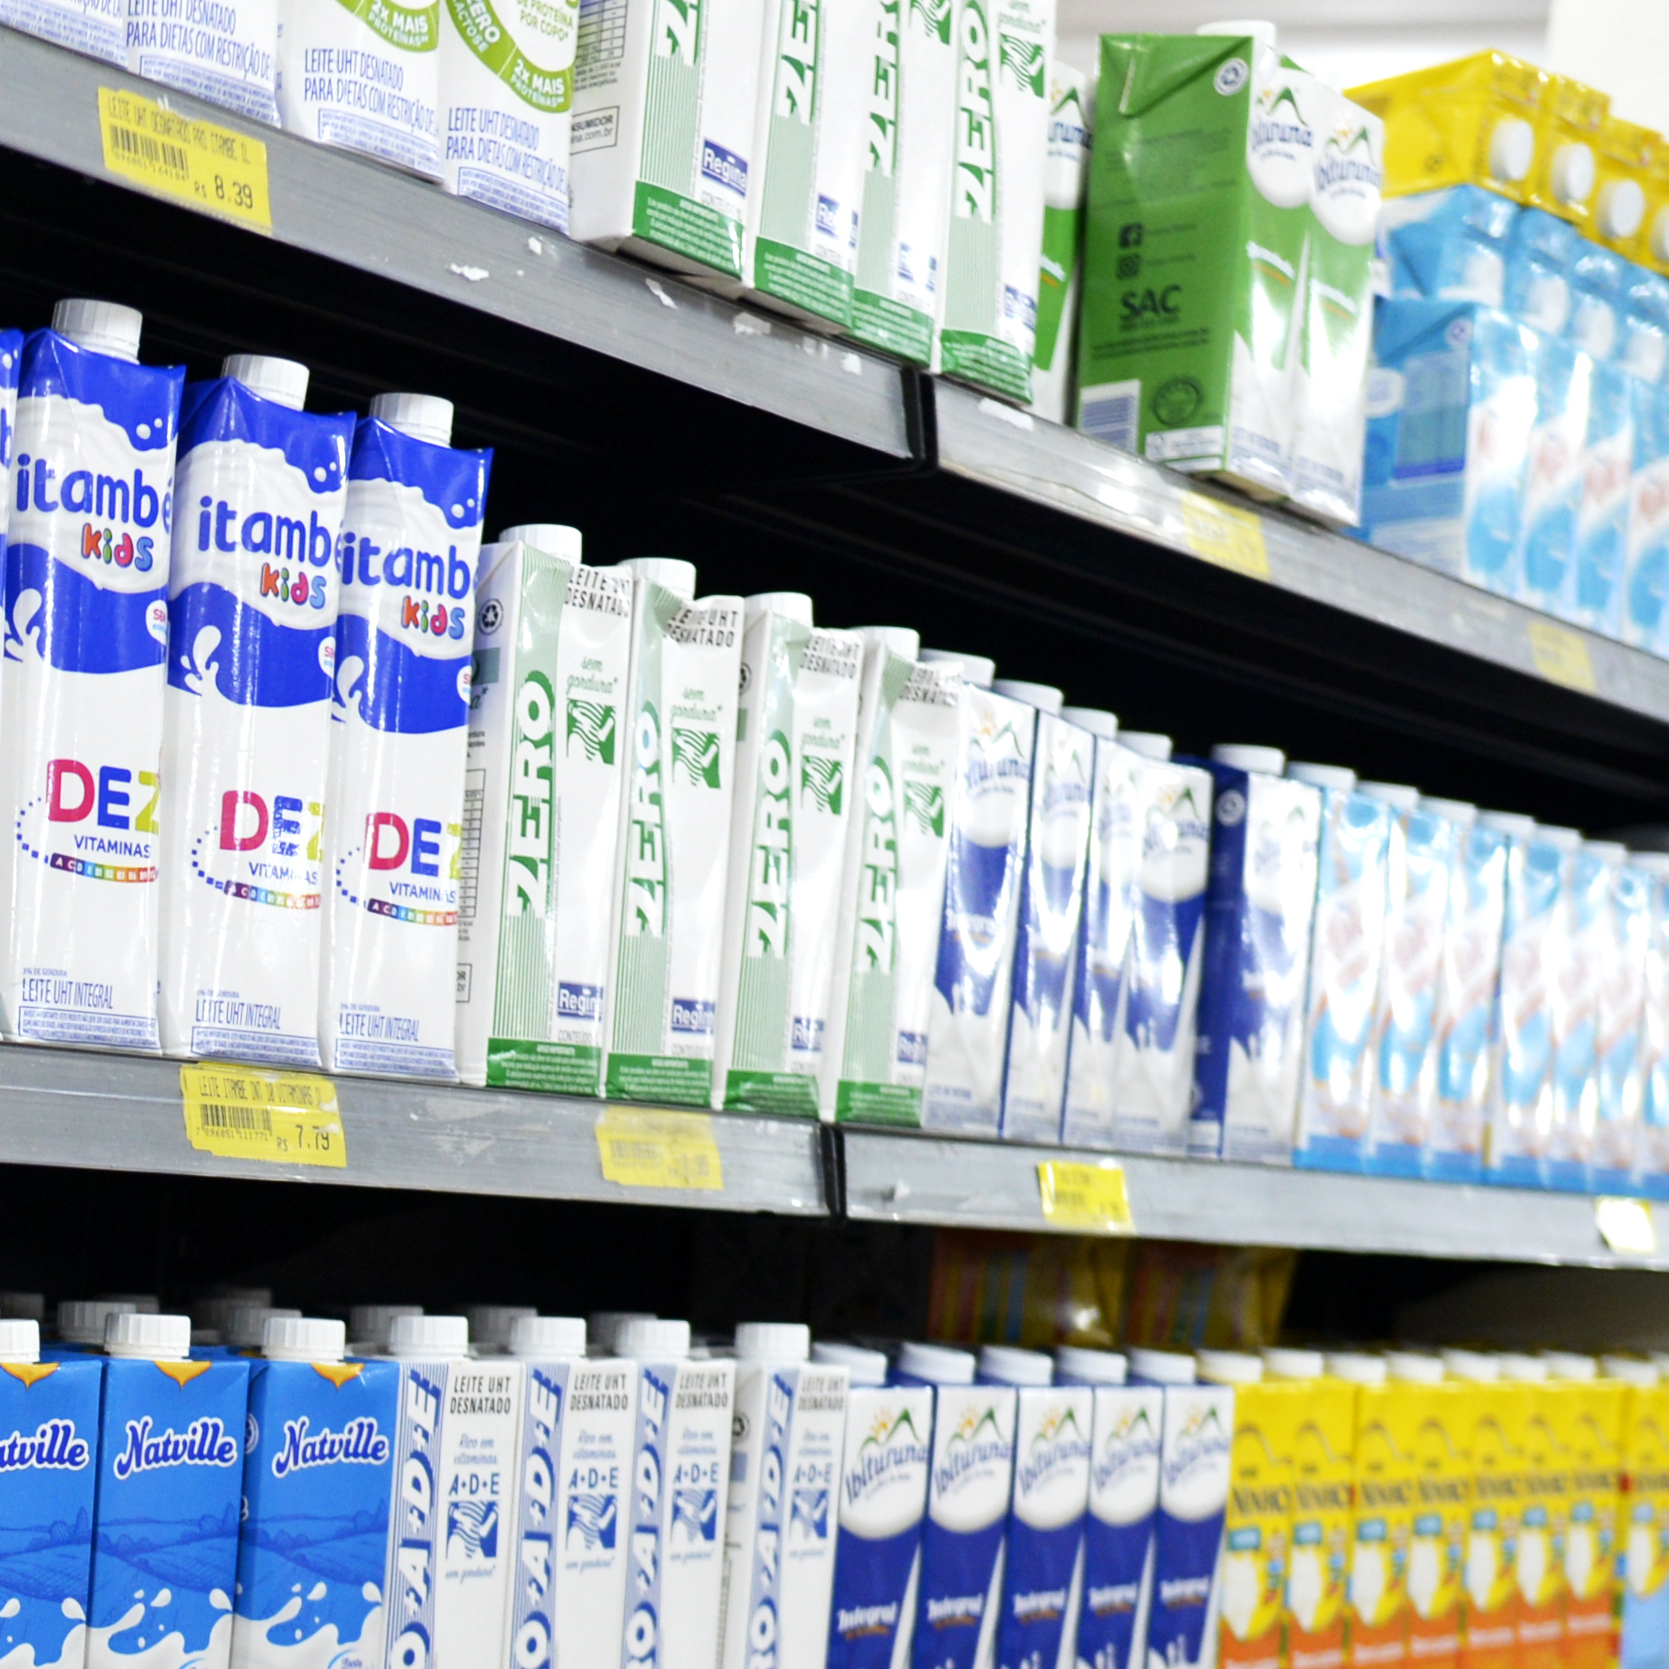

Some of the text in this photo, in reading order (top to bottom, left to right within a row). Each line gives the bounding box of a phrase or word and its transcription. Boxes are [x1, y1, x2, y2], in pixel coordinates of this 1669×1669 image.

[305, 49, 404, 90] LEITE UHT DESNATADO
[305, 78, 333, 102] PARA
[337, 80, 369, 108] DIETAS
[449, 107, 476, 133] LEITE
[215, 173, 254, 209] 8.39
[1119, 286, 1183, 328] SAC
[81, 523, 153, 573] kids
[343, 530, 472, 598] itamb
[260, 562, 327, 609] kids
[401, 595, 465, 640] kids
[510, 672, 555, 920] ZERO
[629, 702, 667, 938] ZERO
[73, 834, 151, 859] VITAMINAS
[754, 731, 794, 960] ZERO
[860, 757, 900, 976] ZERO
[74, 983, 113, 1009] INTEGRAL
[244, 1004, 281, 1030] INTEGRAL
[449, 1396, 512, 1415] DESNATADO
[569, 1394, 629, 1411] DESNATADO
[115, 1413, 238, 1477] Natville
[272, 1413, 389, 1477] Natville
